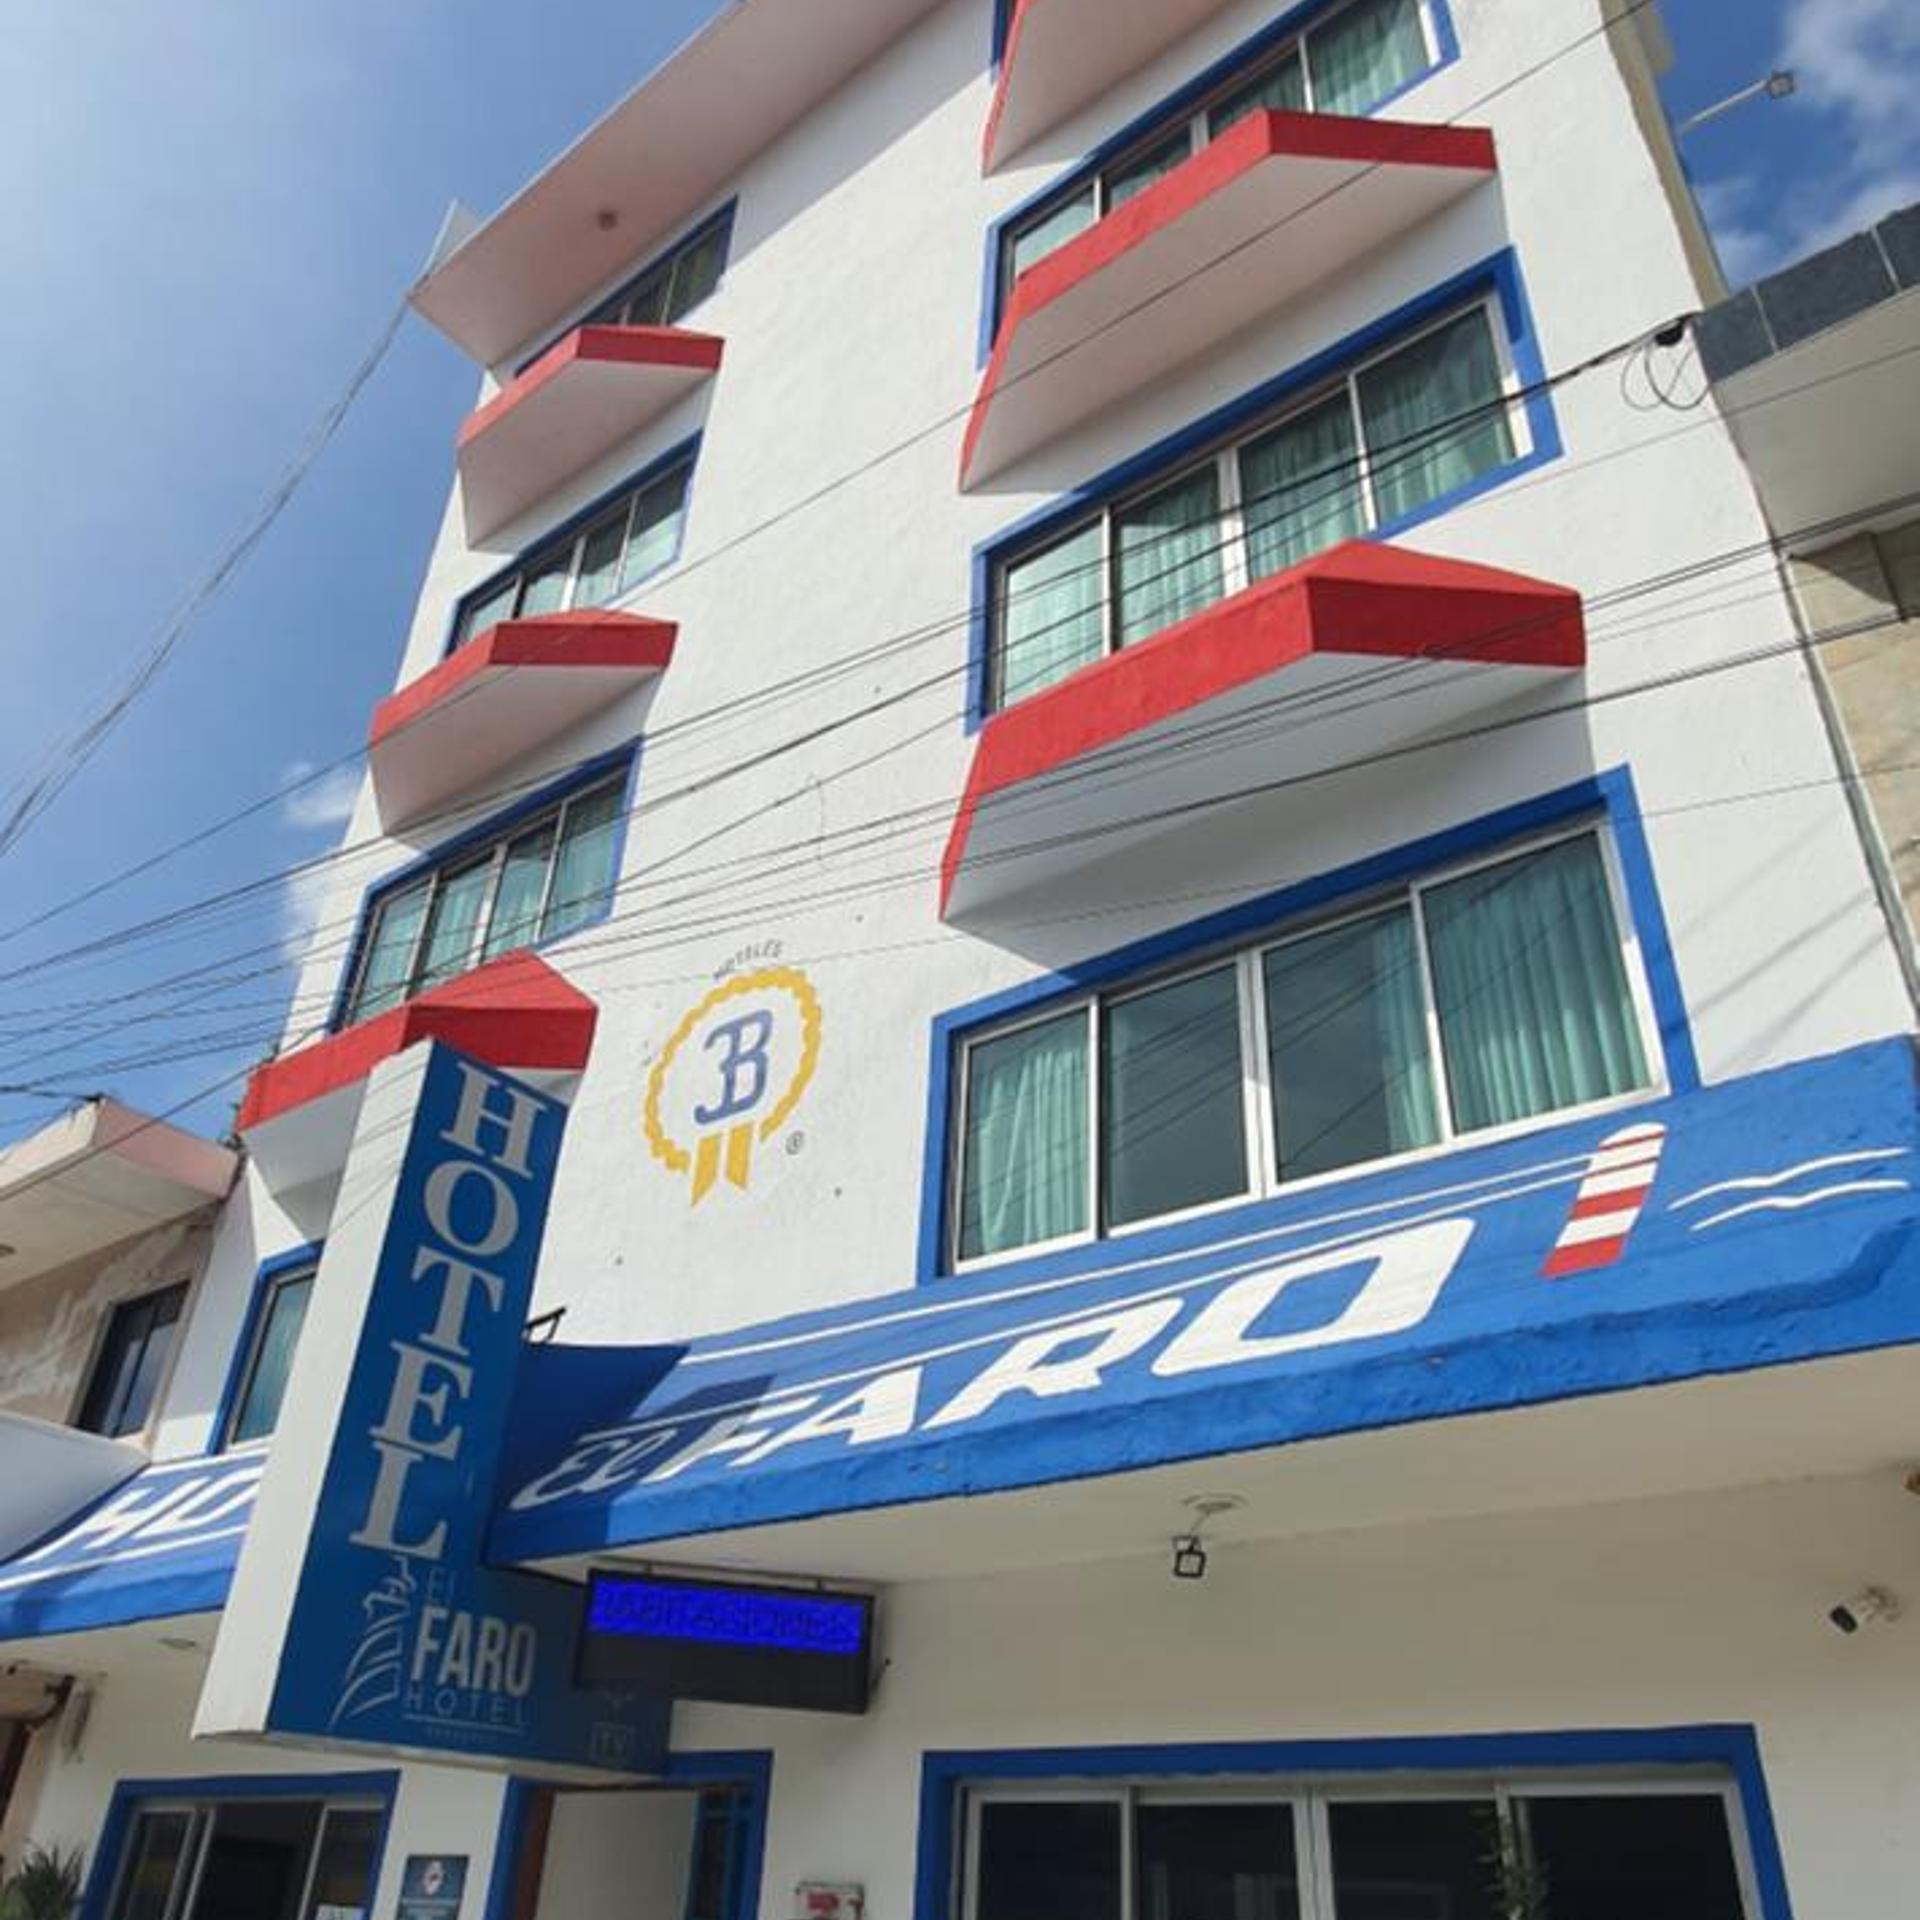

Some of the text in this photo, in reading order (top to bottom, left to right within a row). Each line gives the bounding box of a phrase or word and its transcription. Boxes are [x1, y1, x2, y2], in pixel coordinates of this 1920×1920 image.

[348, 1060, 549, 1559] HOTEL
[637, 1218, 1476, 1484] FARO
[404, 1679, 529, 1726] HOTEL
[410, 1604, 537, 1698] FARO
